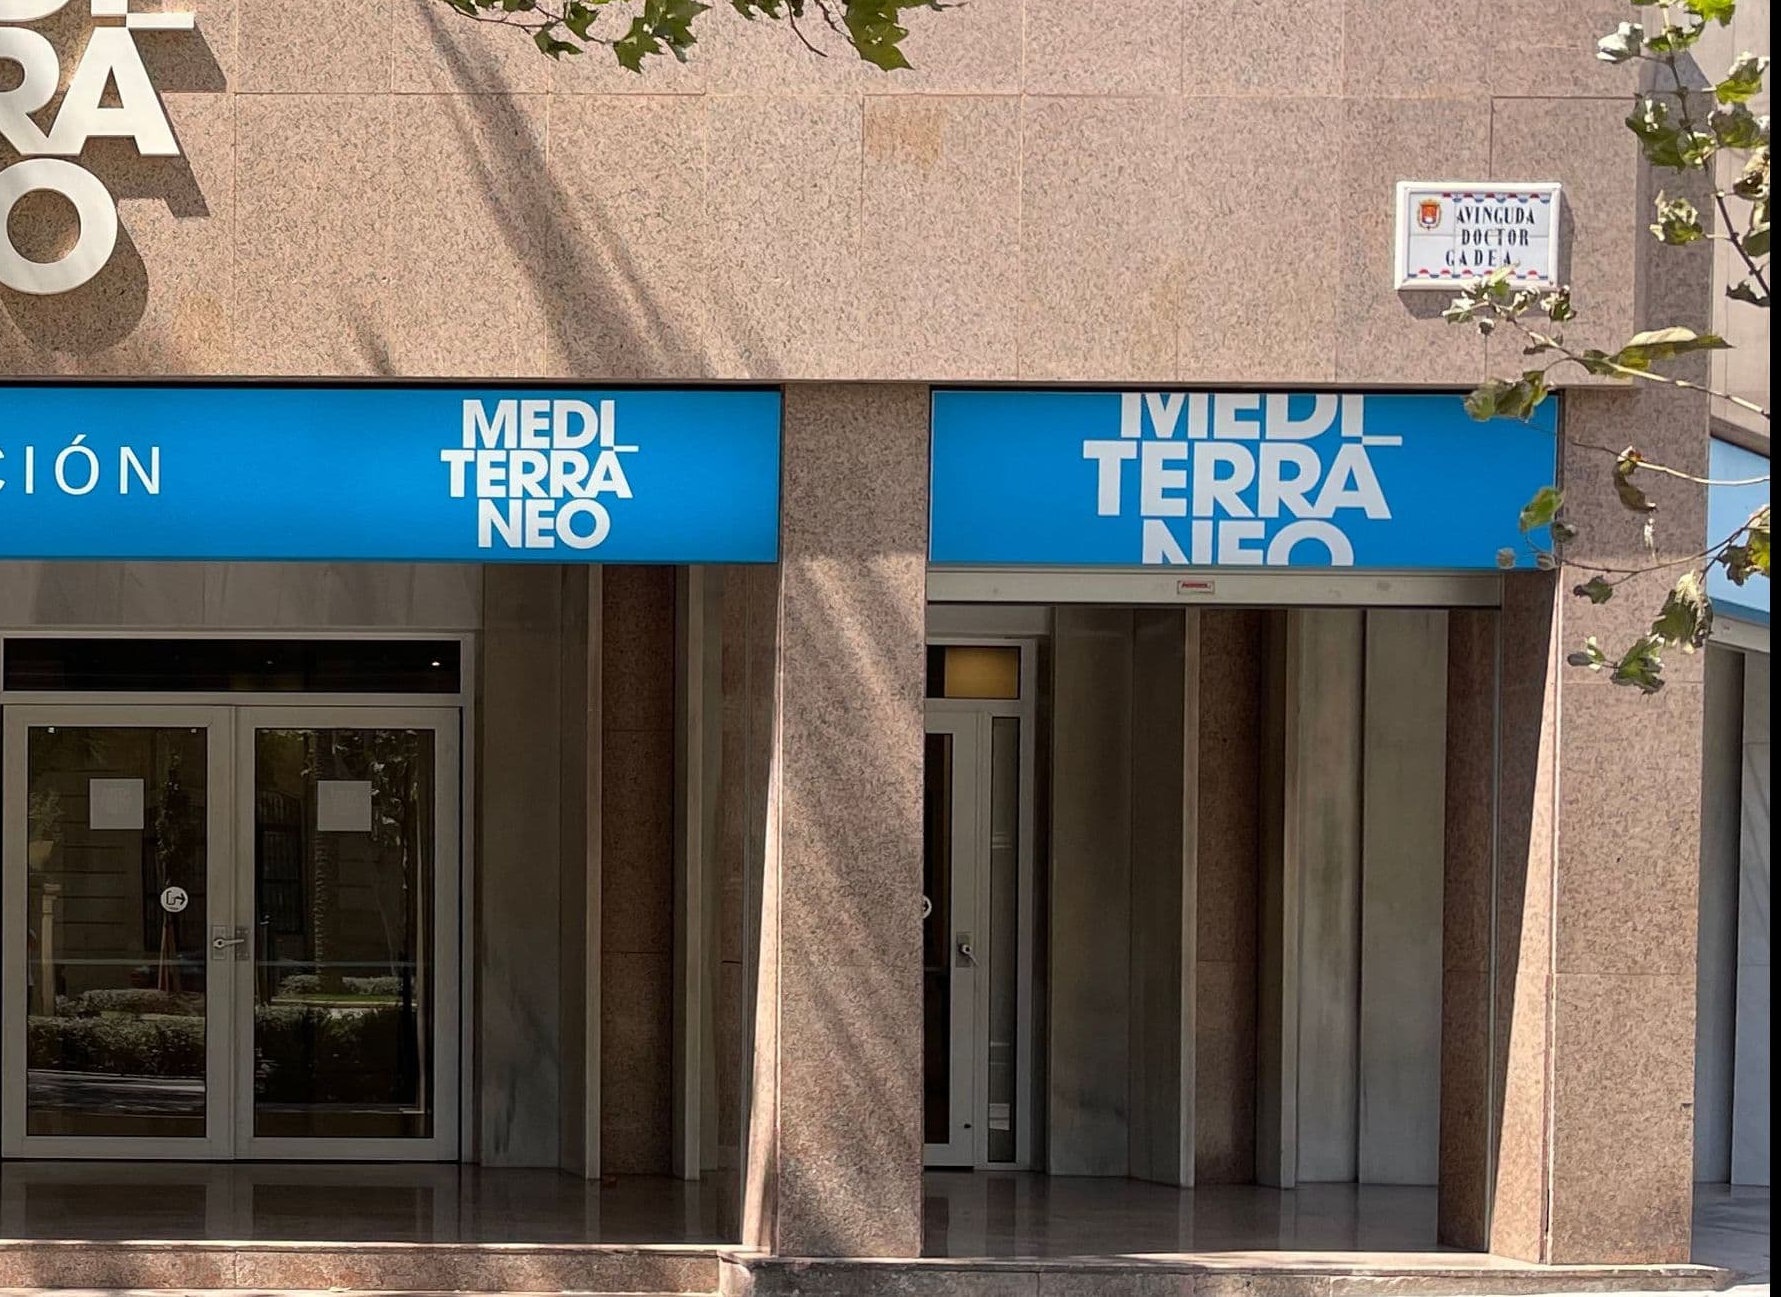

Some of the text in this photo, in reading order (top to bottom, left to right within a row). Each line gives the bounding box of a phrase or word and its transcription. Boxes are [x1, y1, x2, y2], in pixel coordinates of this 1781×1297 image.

[1456, 206, 1535, 224] AVINGUDA
[1461, 228, 1529, 246] DOCTOR
[1445, 249, 1512, 267] GADEA
[441, 450, 633, 499] TERRA
[1083, 440, 1392, 519] TERRA
[477, 499, 611, 549] NEO
